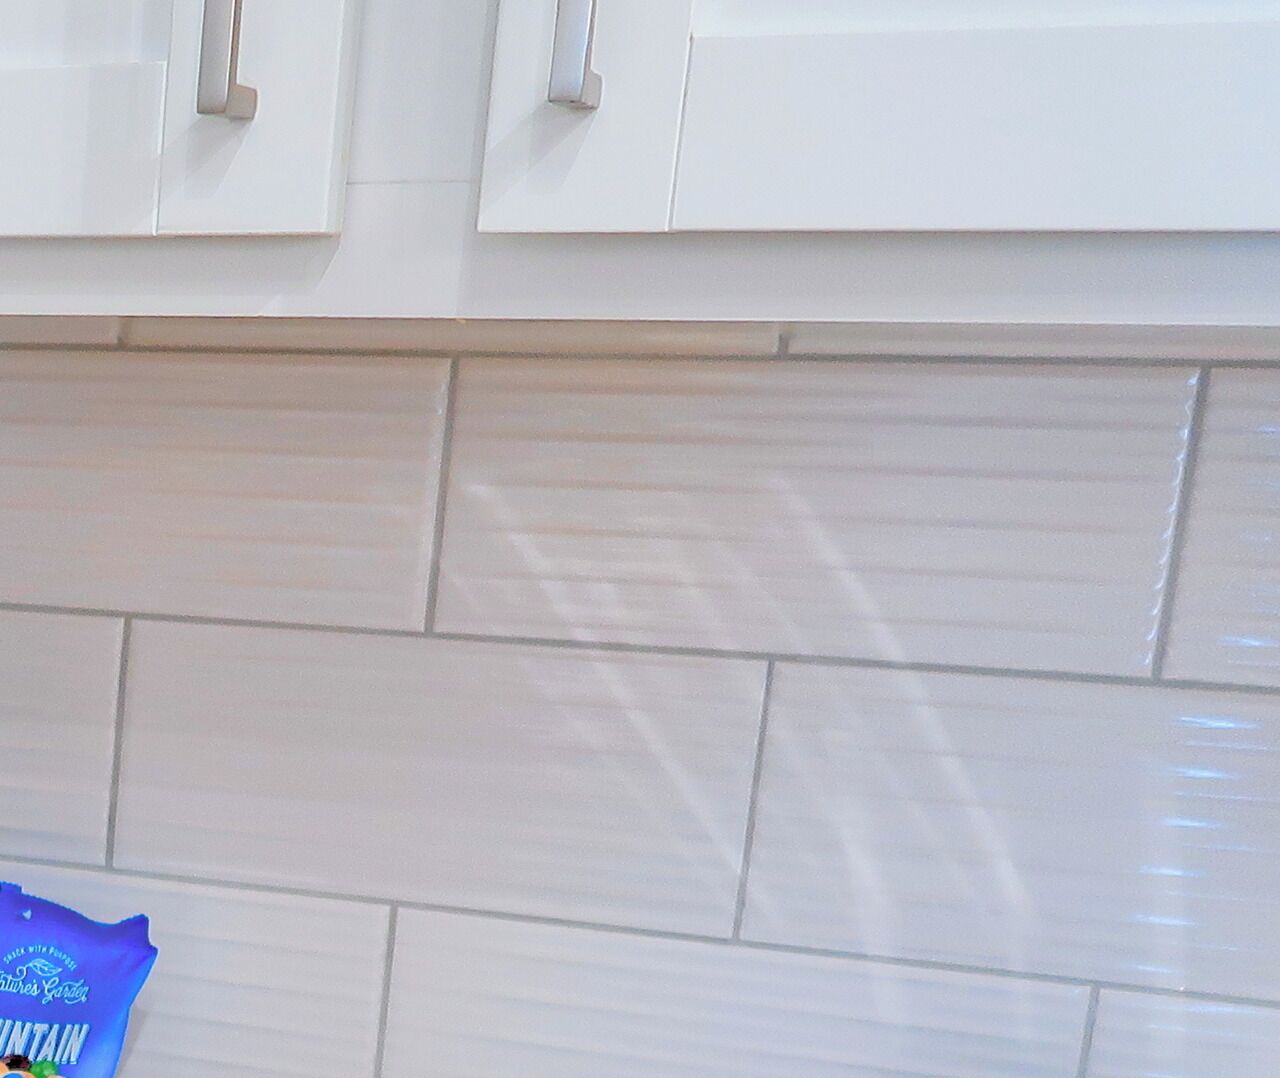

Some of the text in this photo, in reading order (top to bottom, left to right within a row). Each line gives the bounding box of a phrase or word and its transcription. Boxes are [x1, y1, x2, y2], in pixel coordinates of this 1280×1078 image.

[2, 944, 78, 971] SNACK WITH PURPOSE
[41, 977, 89, 1004] Garden
